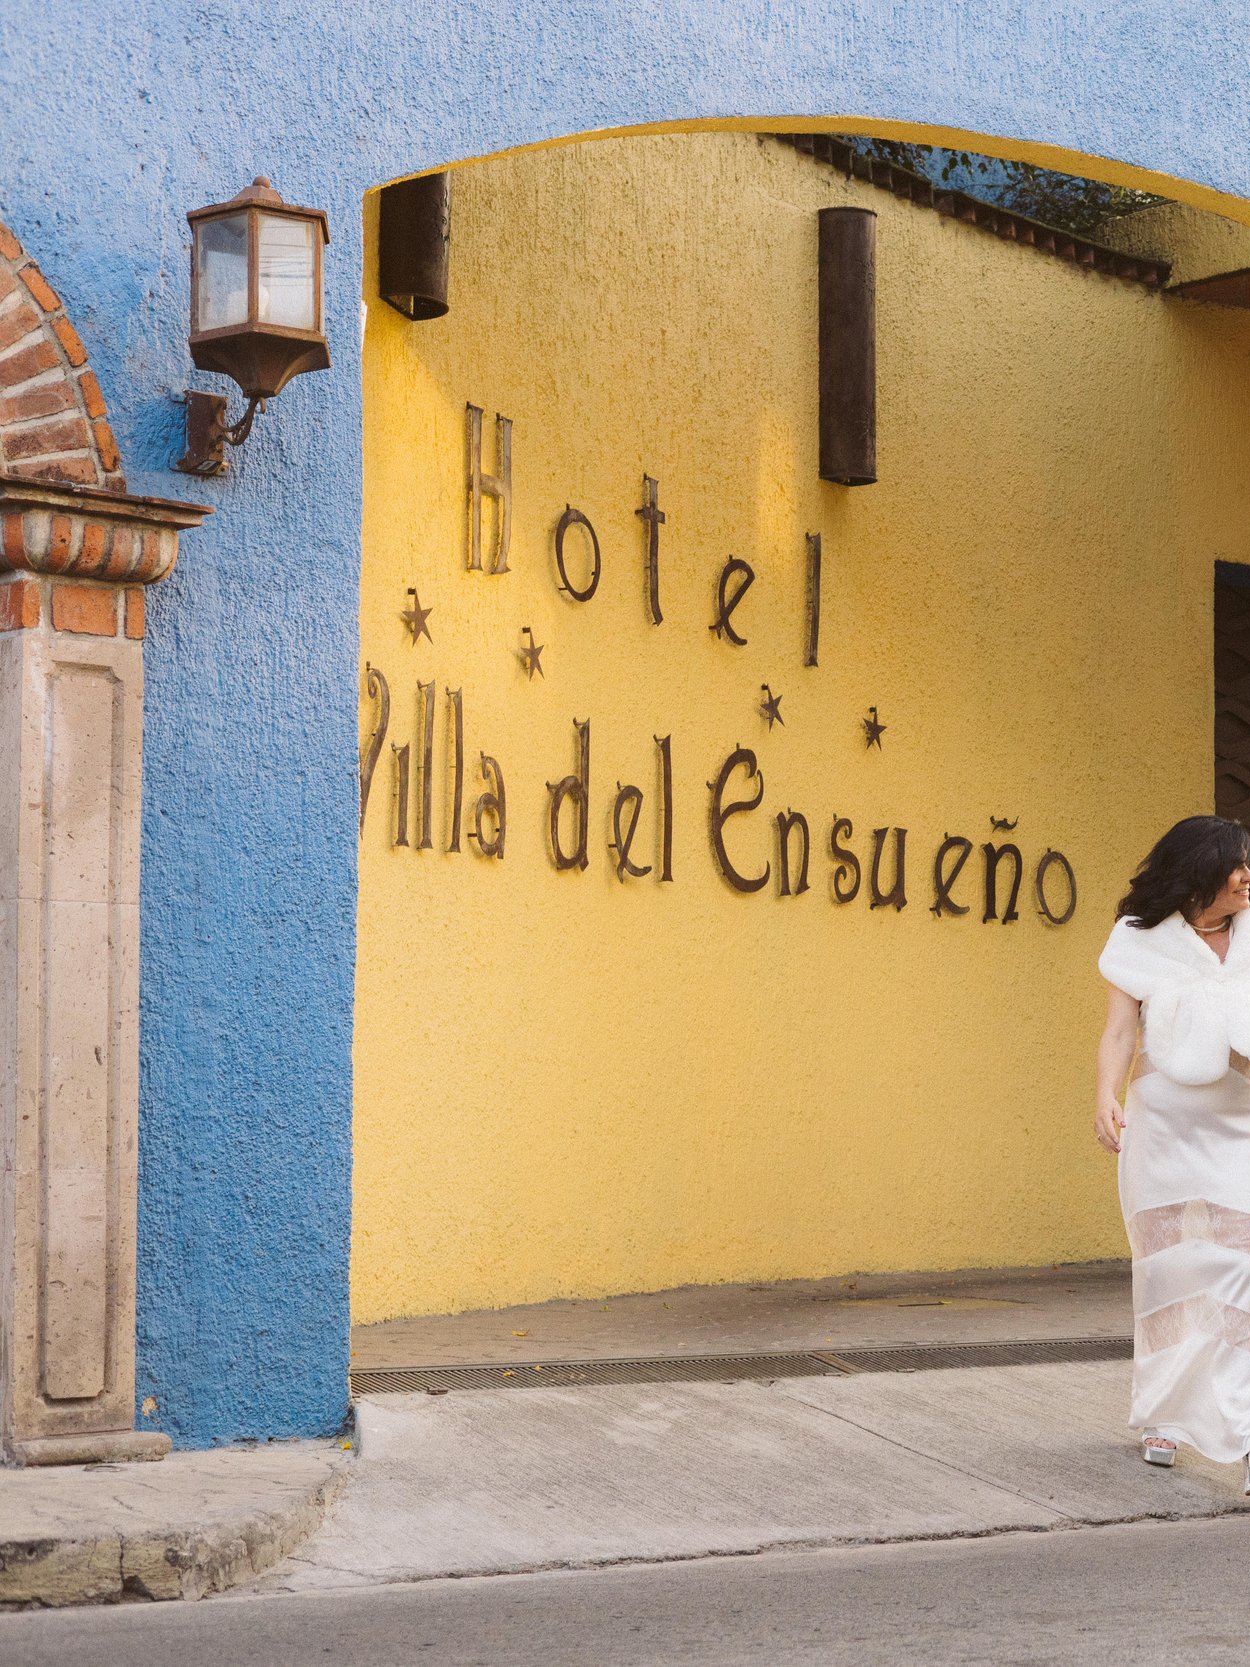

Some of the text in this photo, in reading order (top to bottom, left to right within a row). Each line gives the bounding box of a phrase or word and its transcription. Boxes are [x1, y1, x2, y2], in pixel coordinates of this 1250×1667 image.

[466, 402, 822, 668] Hotel
[545, 717, 674, 884] del
[707, 744, 1077, 926] Ensueño
